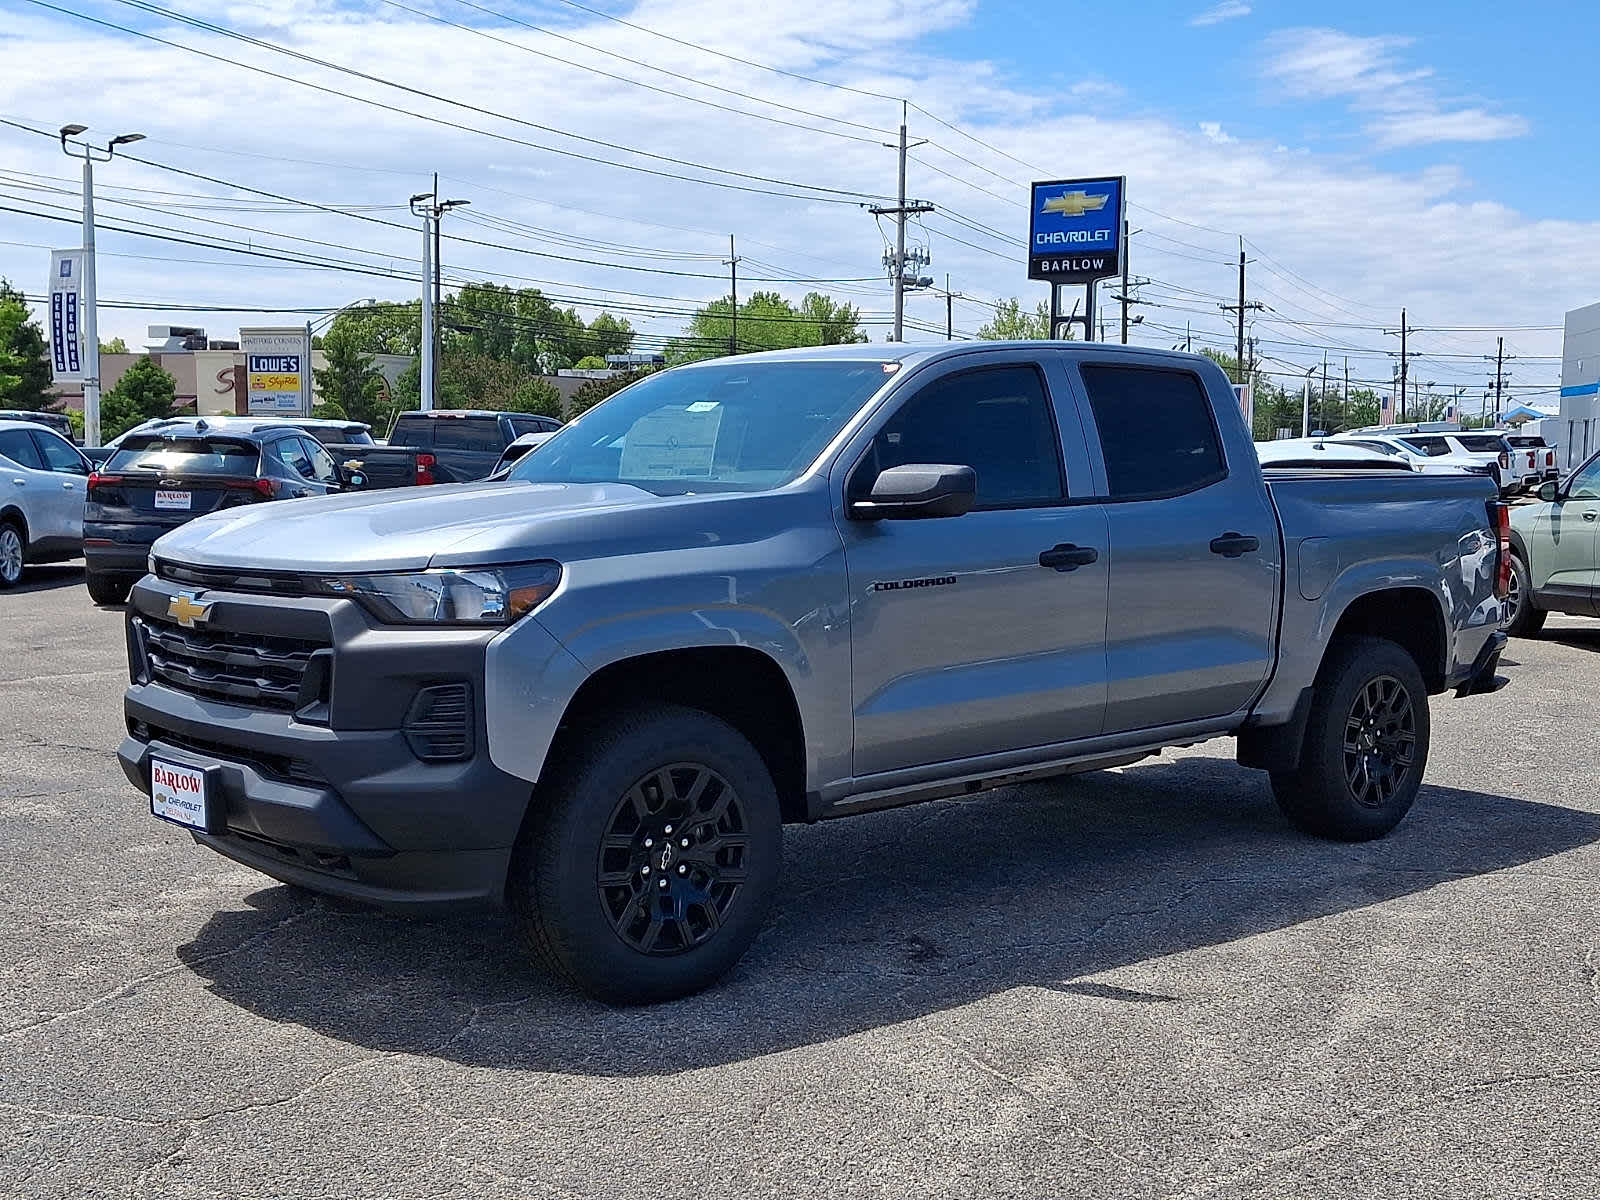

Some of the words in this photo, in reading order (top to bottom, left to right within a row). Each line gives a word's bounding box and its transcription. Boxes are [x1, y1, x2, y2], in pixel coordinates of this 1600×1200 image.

[1037, 229, 1111, 244] CHEVROLET
[1041, 259, 1104, 271] BARLOW
[54, 293, 64, 371] CERTIFIED
[251, 356, 297, 371] LOWE'S
[157, 492, 190, 500] BARLOW
[874, 576, 957, 592] COLORADO
[154, 767, 201, 795] BARLOW
[168, 797, 202, 812] CHEVROLET
